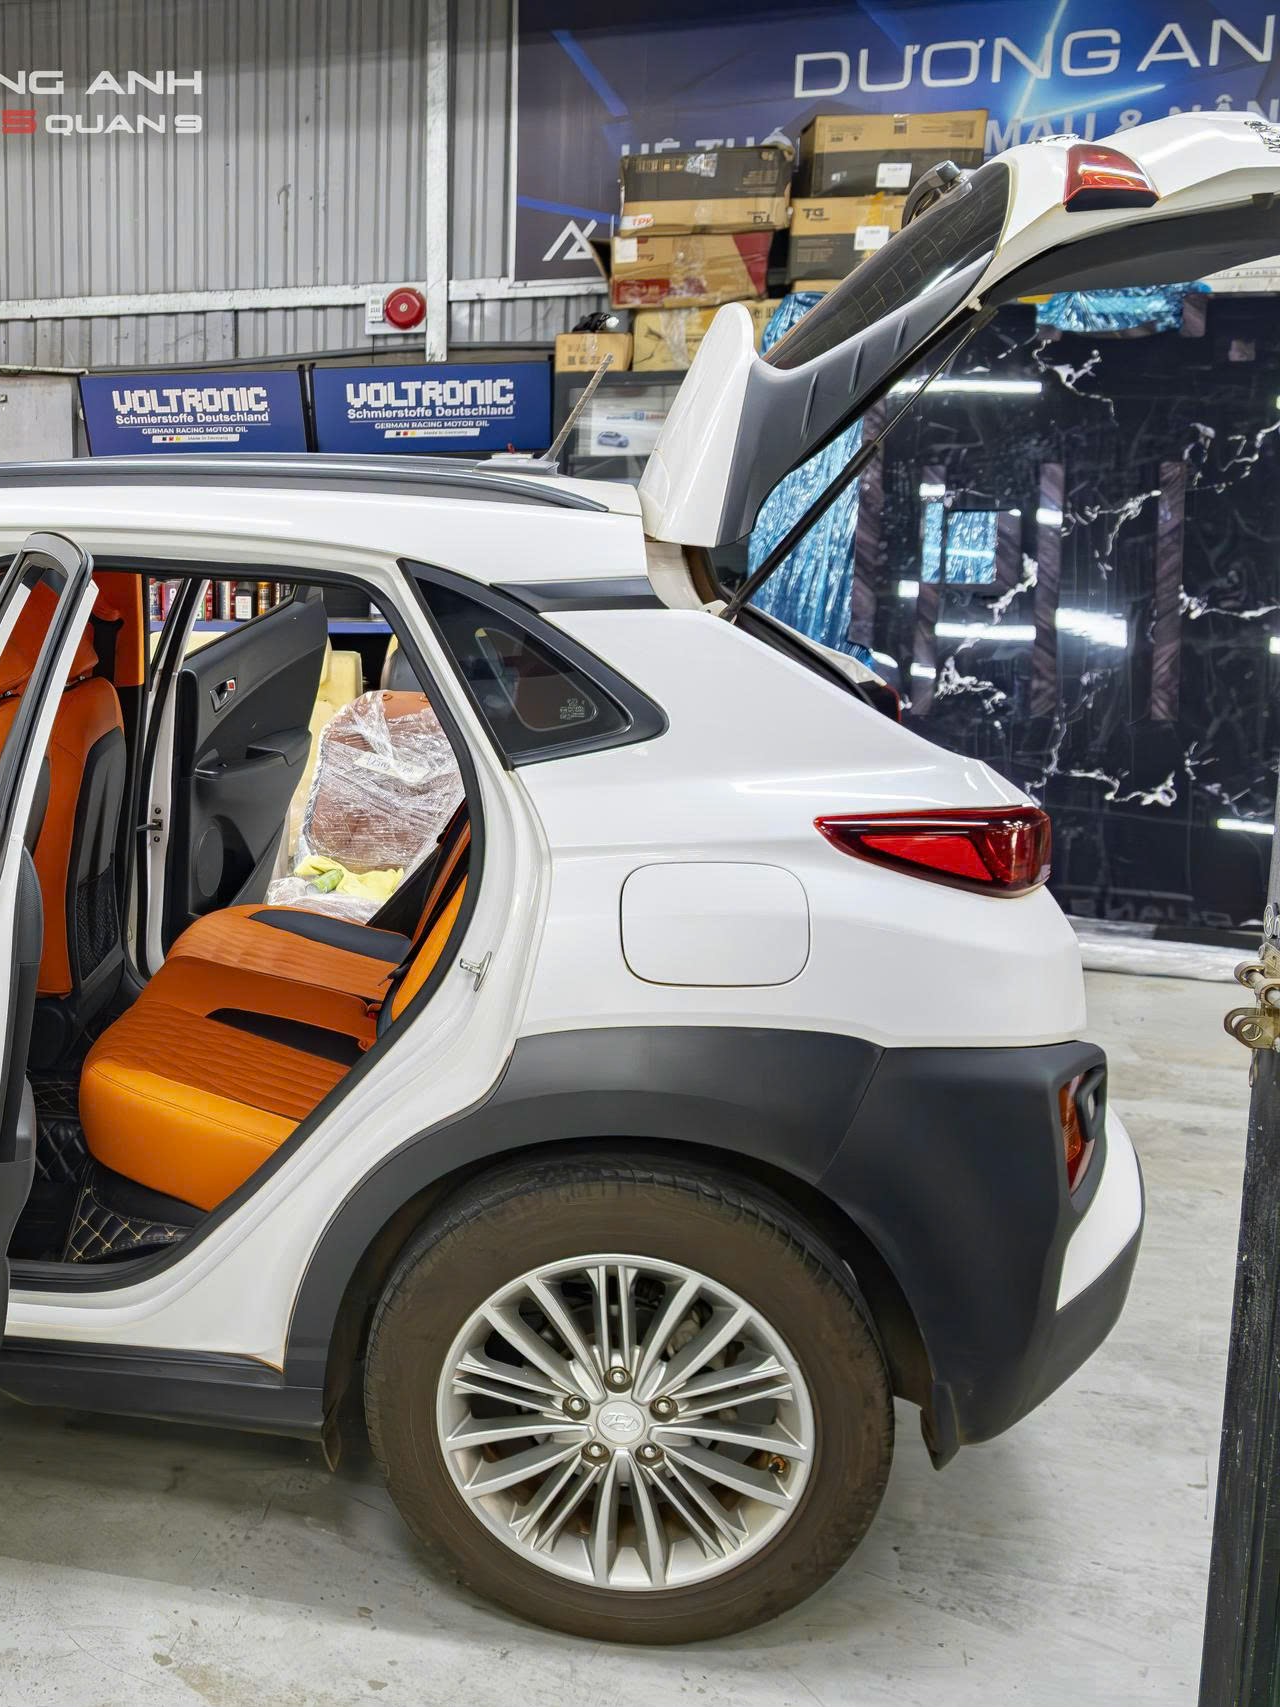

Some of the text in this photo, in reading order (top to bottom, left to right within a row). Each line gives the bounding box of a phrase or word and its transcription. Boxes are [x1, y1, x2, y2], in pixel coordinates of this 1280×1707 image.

[793, 28, 1121, 99] DƯƠNG
[111, 386, 269, 415] VOLTRONIC
[345, 378, 515, 408] VOLTRONIC
[115, 411, 269, 425] Schmierstoffe Deutschland
[347, 405, 514, 420] Schmierstoffe Deutschland
[141, 427, 175, 435] GERMAN
[175, 426, 205, 434] RACING
[374, 421, 410, 429] GERMAN
[411, 421, 443, 429] RACING
[443, 420, 474, 428] MOTOR
